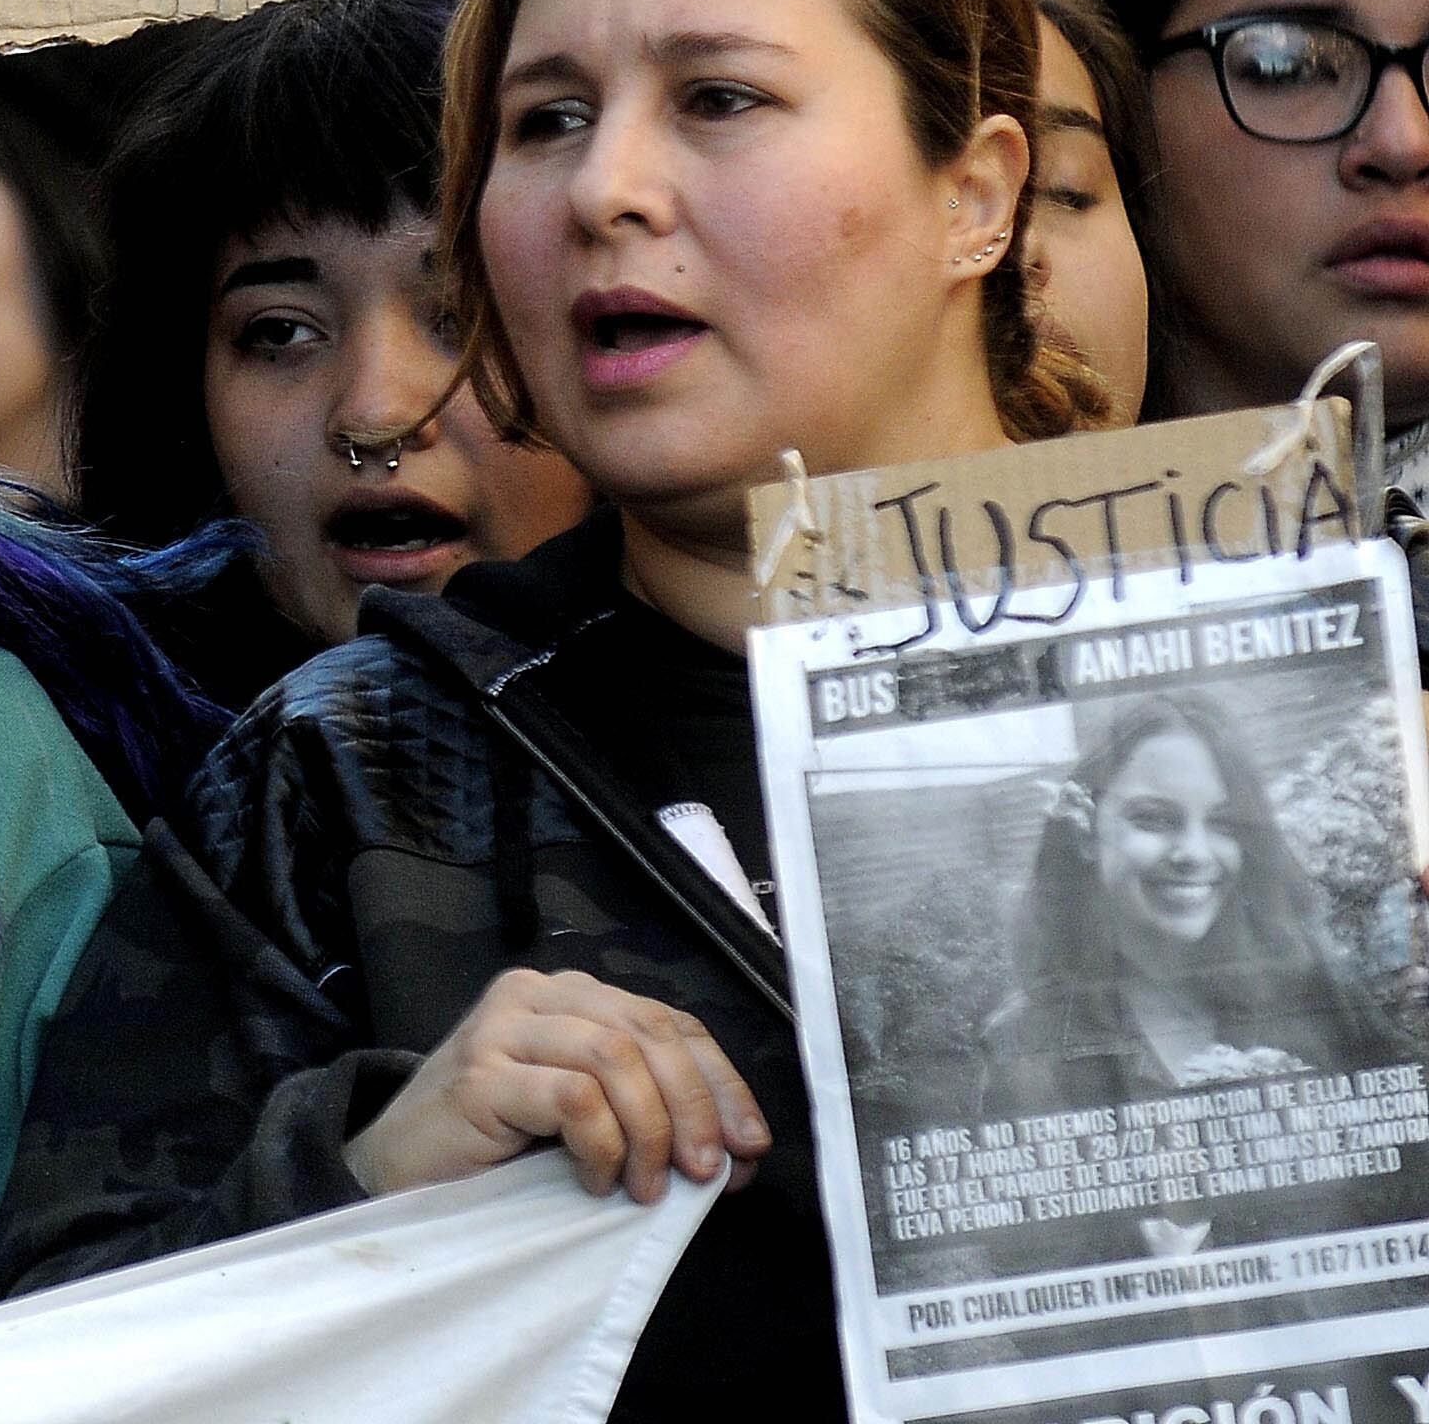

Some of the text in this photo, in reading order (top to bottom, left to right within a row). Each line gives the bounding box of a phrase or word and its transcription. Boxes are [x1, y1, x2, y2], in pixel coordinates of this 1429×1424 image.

[1073, 631, 1192, 685] ANAHI
[1206, 604, 1365, 668] BENITEZ
[889, 1137, 911, 1163] 16
[984, 1123, 1015, 1148] NO
[1018, 1108, 1117, 1143] TENEMOS
[1122, 1087, 1262, 1130] INFORMACION
[1268, 1083, 1297, 1107] DE
[1304, 1074, 1355, 1104] ELLA
[1360, 1063, 1427, 1095] DESDE
[889, 1161, 927, 1190] LAS
[938, 1157, 958, 1183] 17
[967, 1145, 1038, 1177] HORAS
[1044, 1139, 1084, 1167] DEL
[1172, 1122, 1200, 1149] SU
[1207, 1111, 1283, 1143] ULTIMA
[1290, 1090, 1429, 1132] INFORMACION
[891, 1188, 930, 1215] FUE
[933, 1183, 959, 1208] EN
[964, 1179, 989, 1203] EL
[992, 1167, 1074, 1199] PARQUE
[1076, 1164, 1103, 1188] DE
[1108, 1149, 1208, 1183] DEPORTES
[1214, 1146, 1239, 1170] DE
[1244, 1136, 1314, 1165] LOMAS
[1317, 1130, 1343, 1154] DE
[1035, 1179, 1159, 1221] ESTUDIANTE
[1164, 1176, 1204, 1202] DEL
[1208, 1167, 1266, 1196] ENAM
[1271, 1162, 1298, 1187] DE
[1302, 1147, 1402, 1183] BANFIELD
[909, 1299, 957, 1333] POR
[963, 1279, 1095, 1325] CUALQUIER
[1104, 1255, 1280, 1304] INFORMACION:
